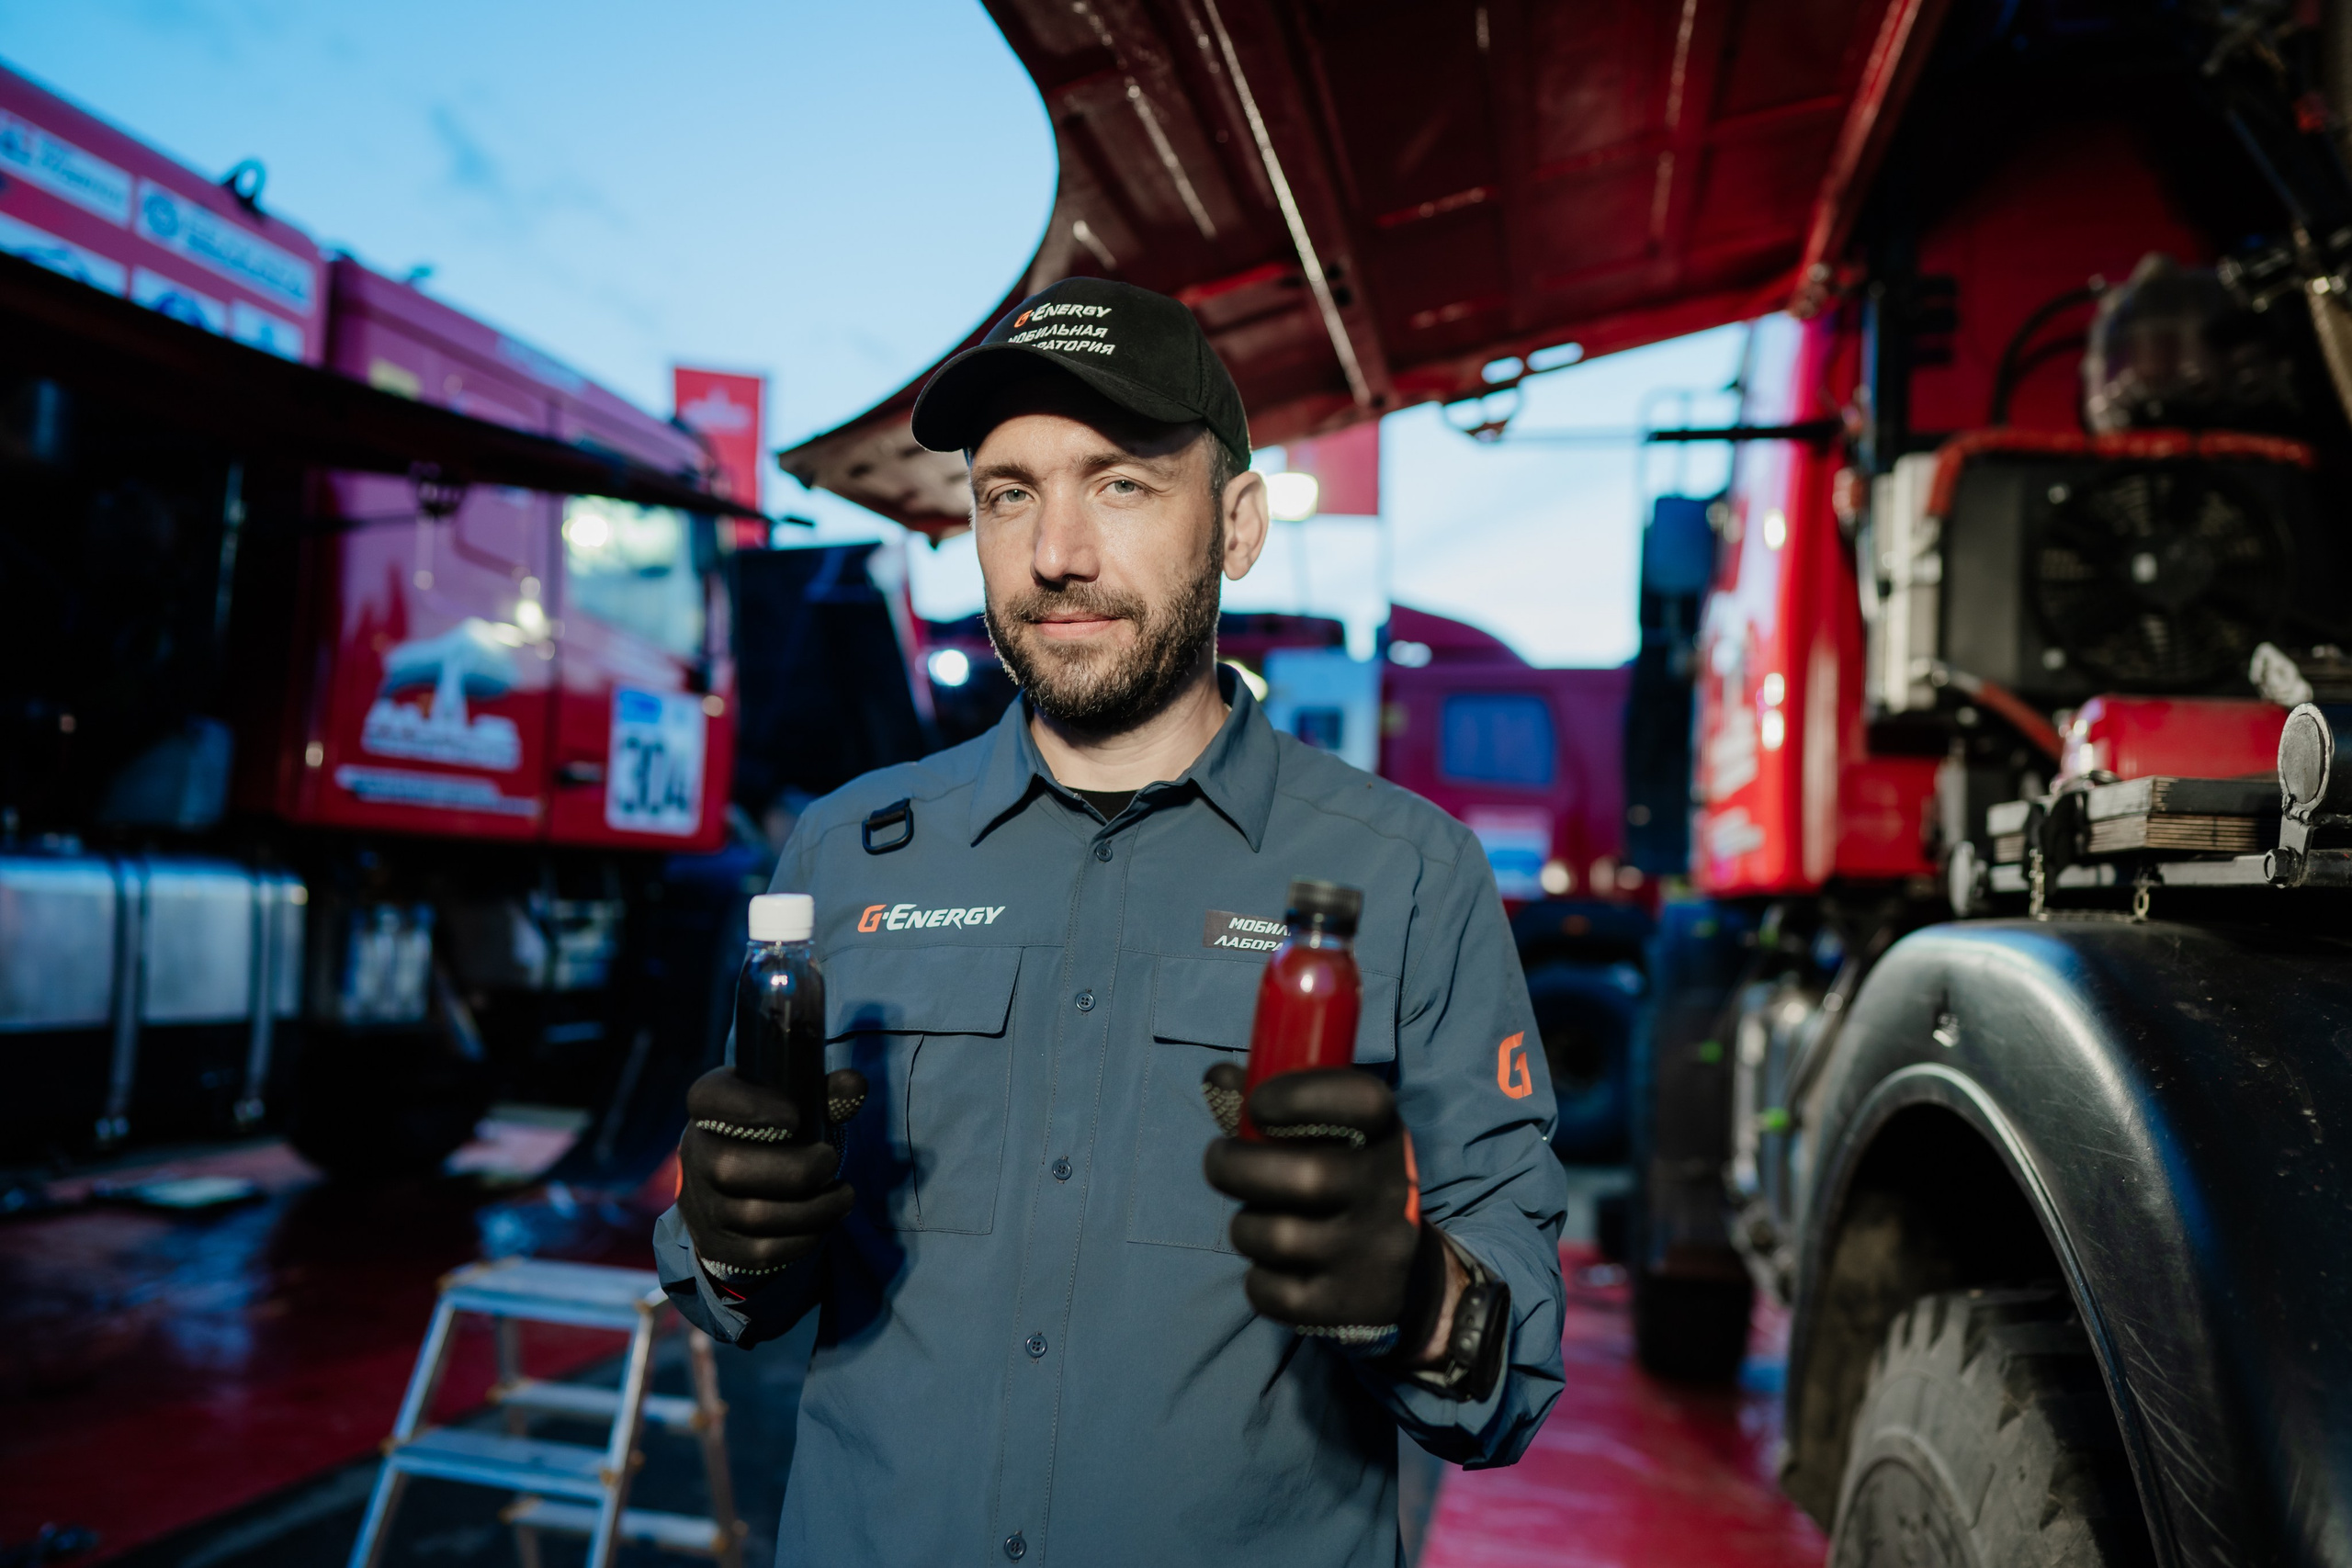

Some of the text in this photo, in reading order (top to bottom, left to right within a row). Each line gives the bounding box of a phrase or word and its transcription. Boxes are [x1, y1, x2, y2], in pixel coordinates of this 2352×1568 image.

[1032, 339, 1116, 355] РАТОРИЯ
[1228, 917, 1292, 937] МОБИЛ
[1497, 1030, 1533, 1100] G
